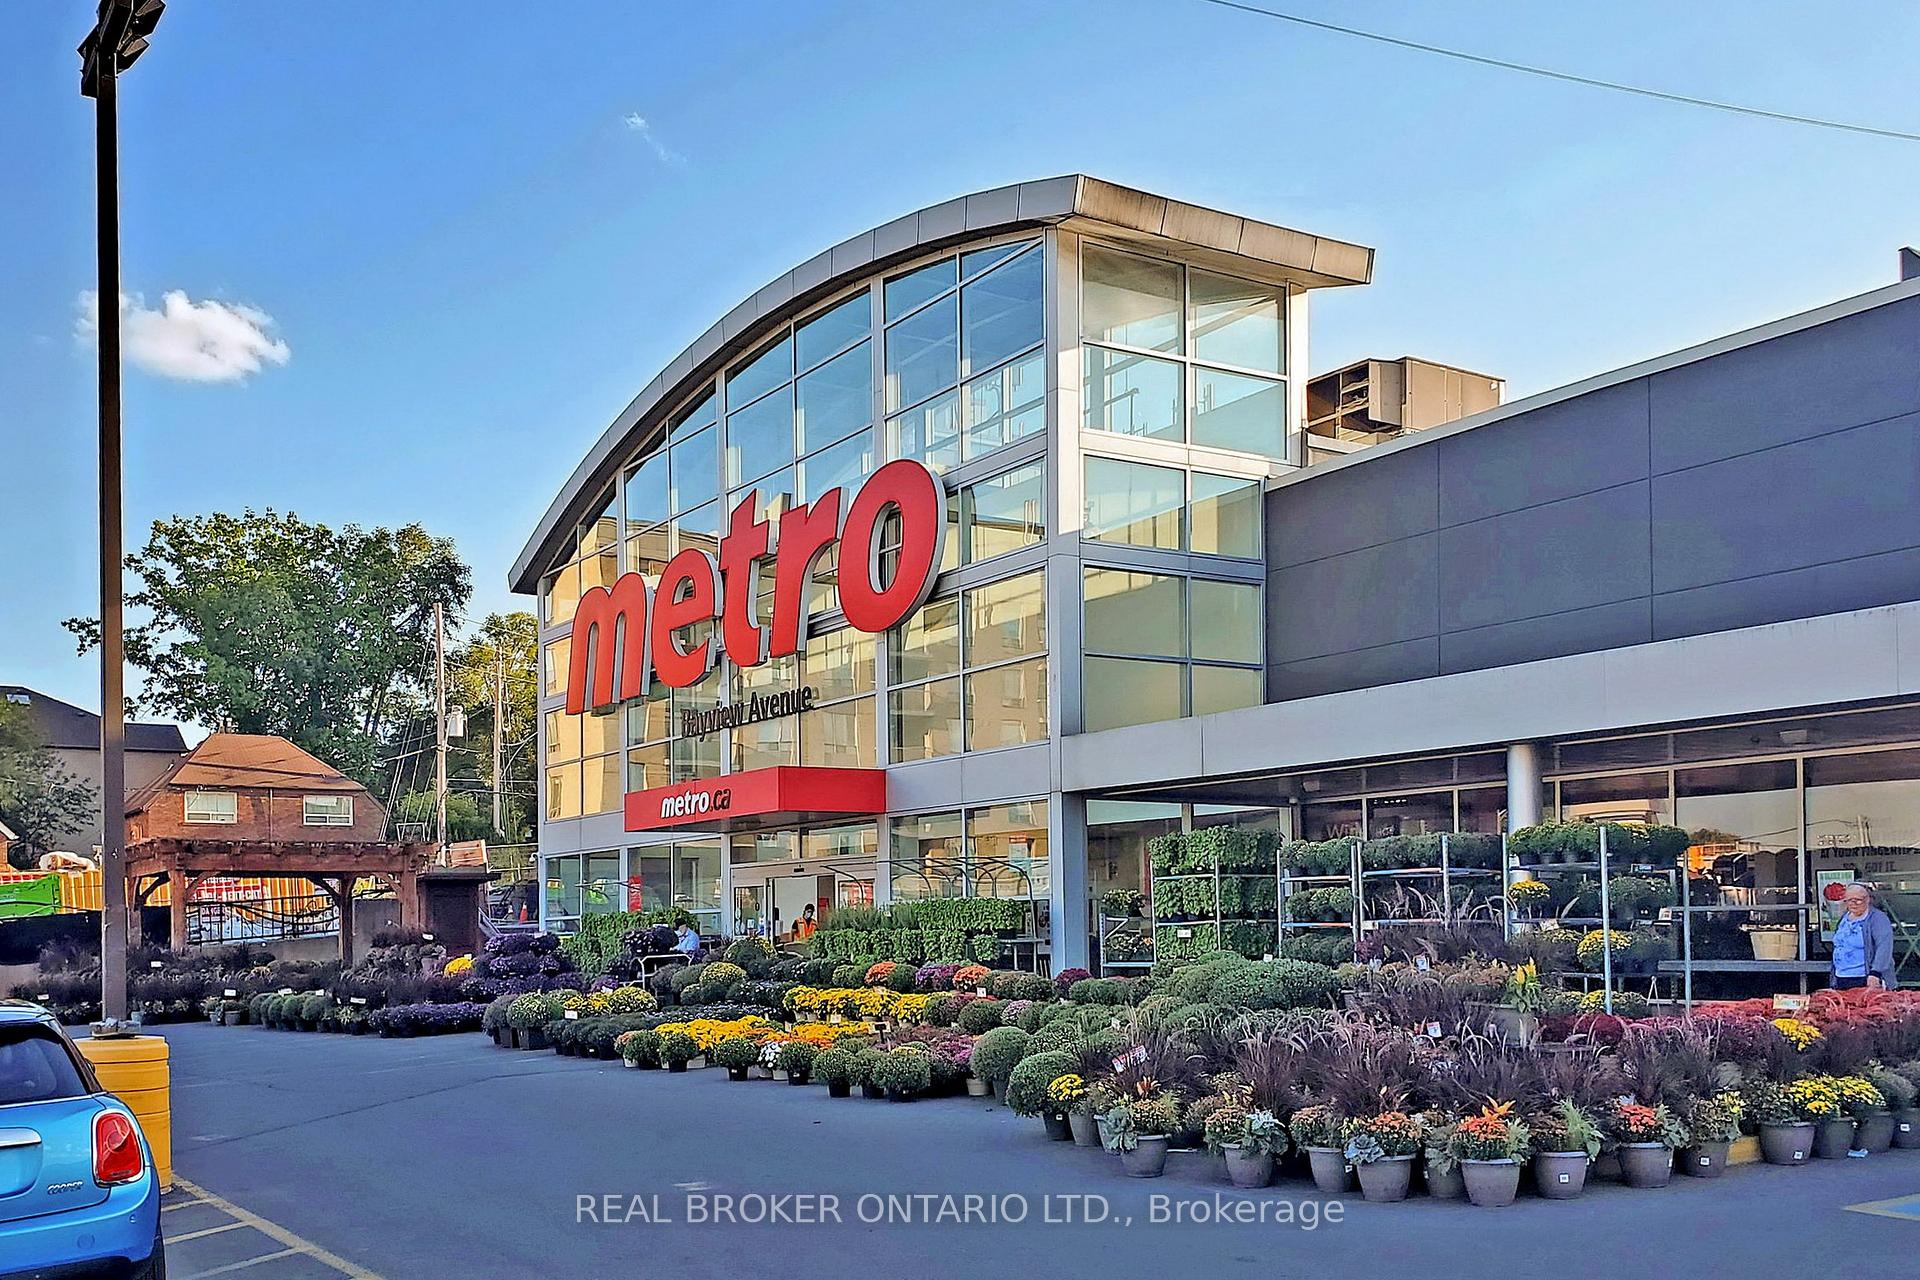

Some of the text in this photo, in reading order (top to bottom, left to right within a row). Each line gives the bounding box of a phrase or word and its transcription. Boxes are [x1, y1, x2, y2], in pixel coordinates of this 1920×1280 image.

[566, 458, 946, 715] metro
[681, 685, 814, 742] Bayview Avenue
[660, 788, 732, 819] metro.ca
[47, 1180, 84, 1195] COOPER
